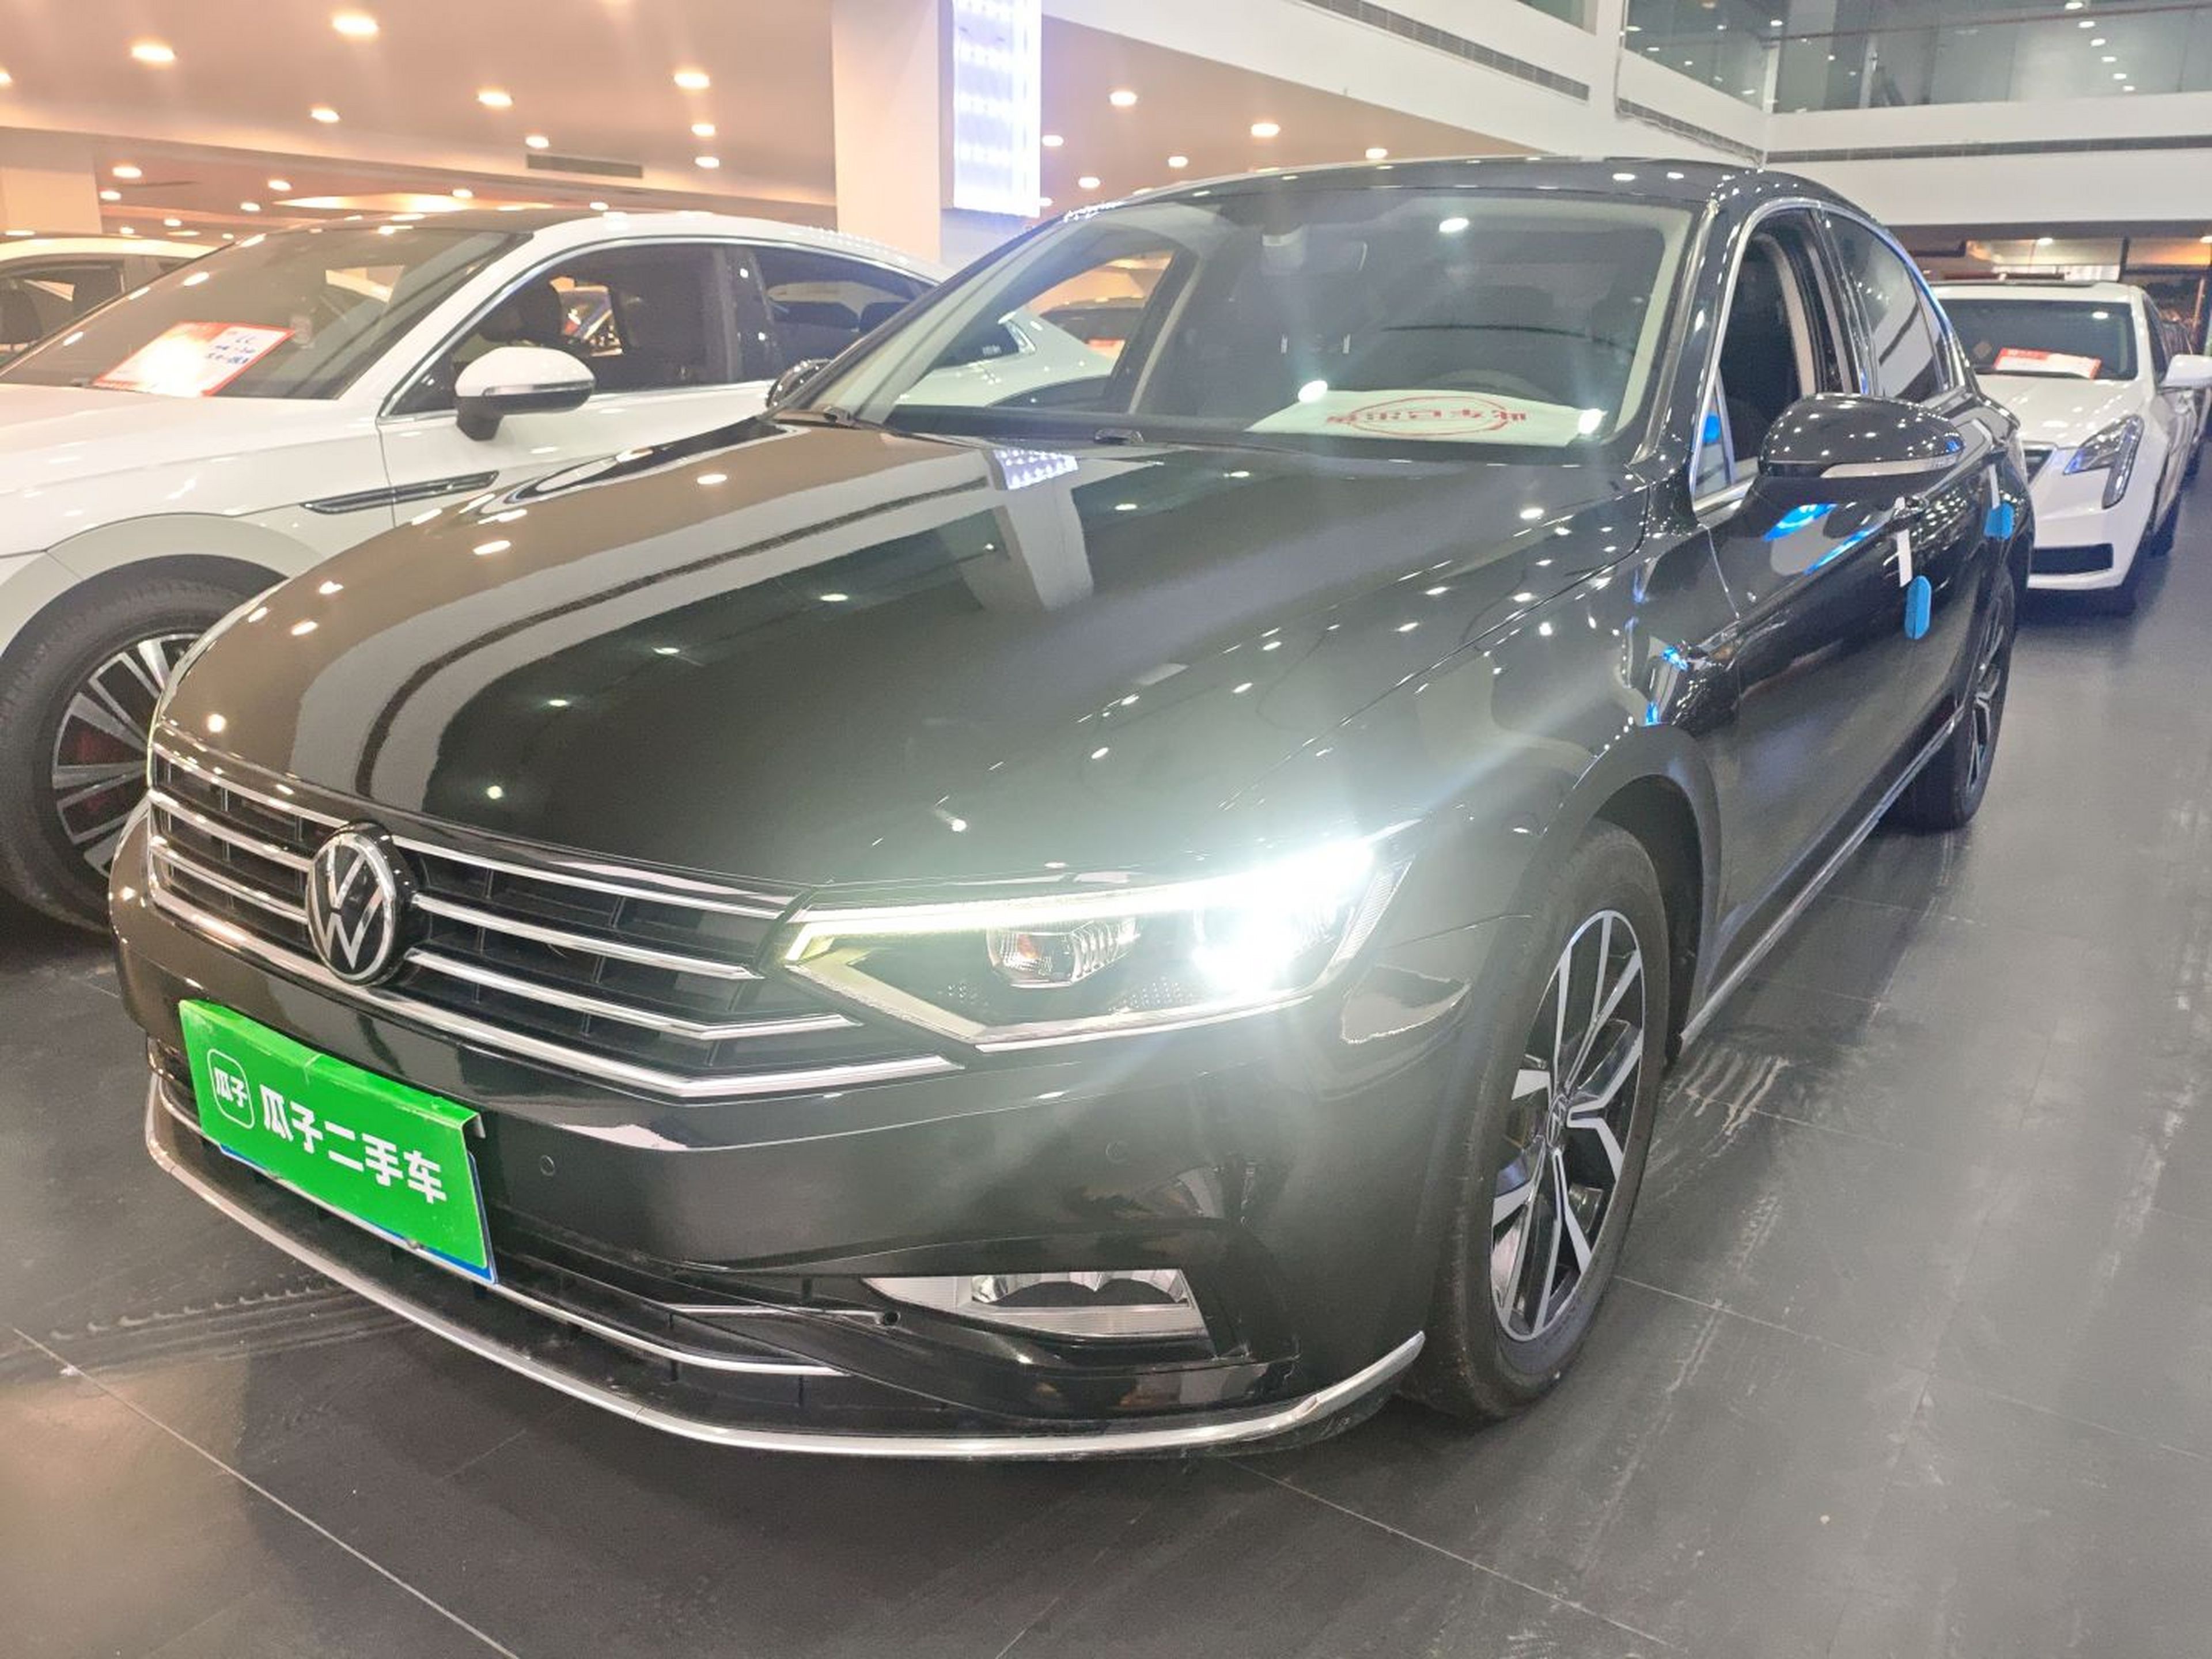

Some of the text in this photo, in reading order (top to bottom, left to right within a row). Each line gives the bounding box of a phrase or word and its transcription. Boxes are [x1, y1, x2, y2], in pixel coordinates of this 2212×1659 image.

[213, 1067, 248, 1108] 瓜子
[260, 1084, 447, 1205] 瓜子二手车
